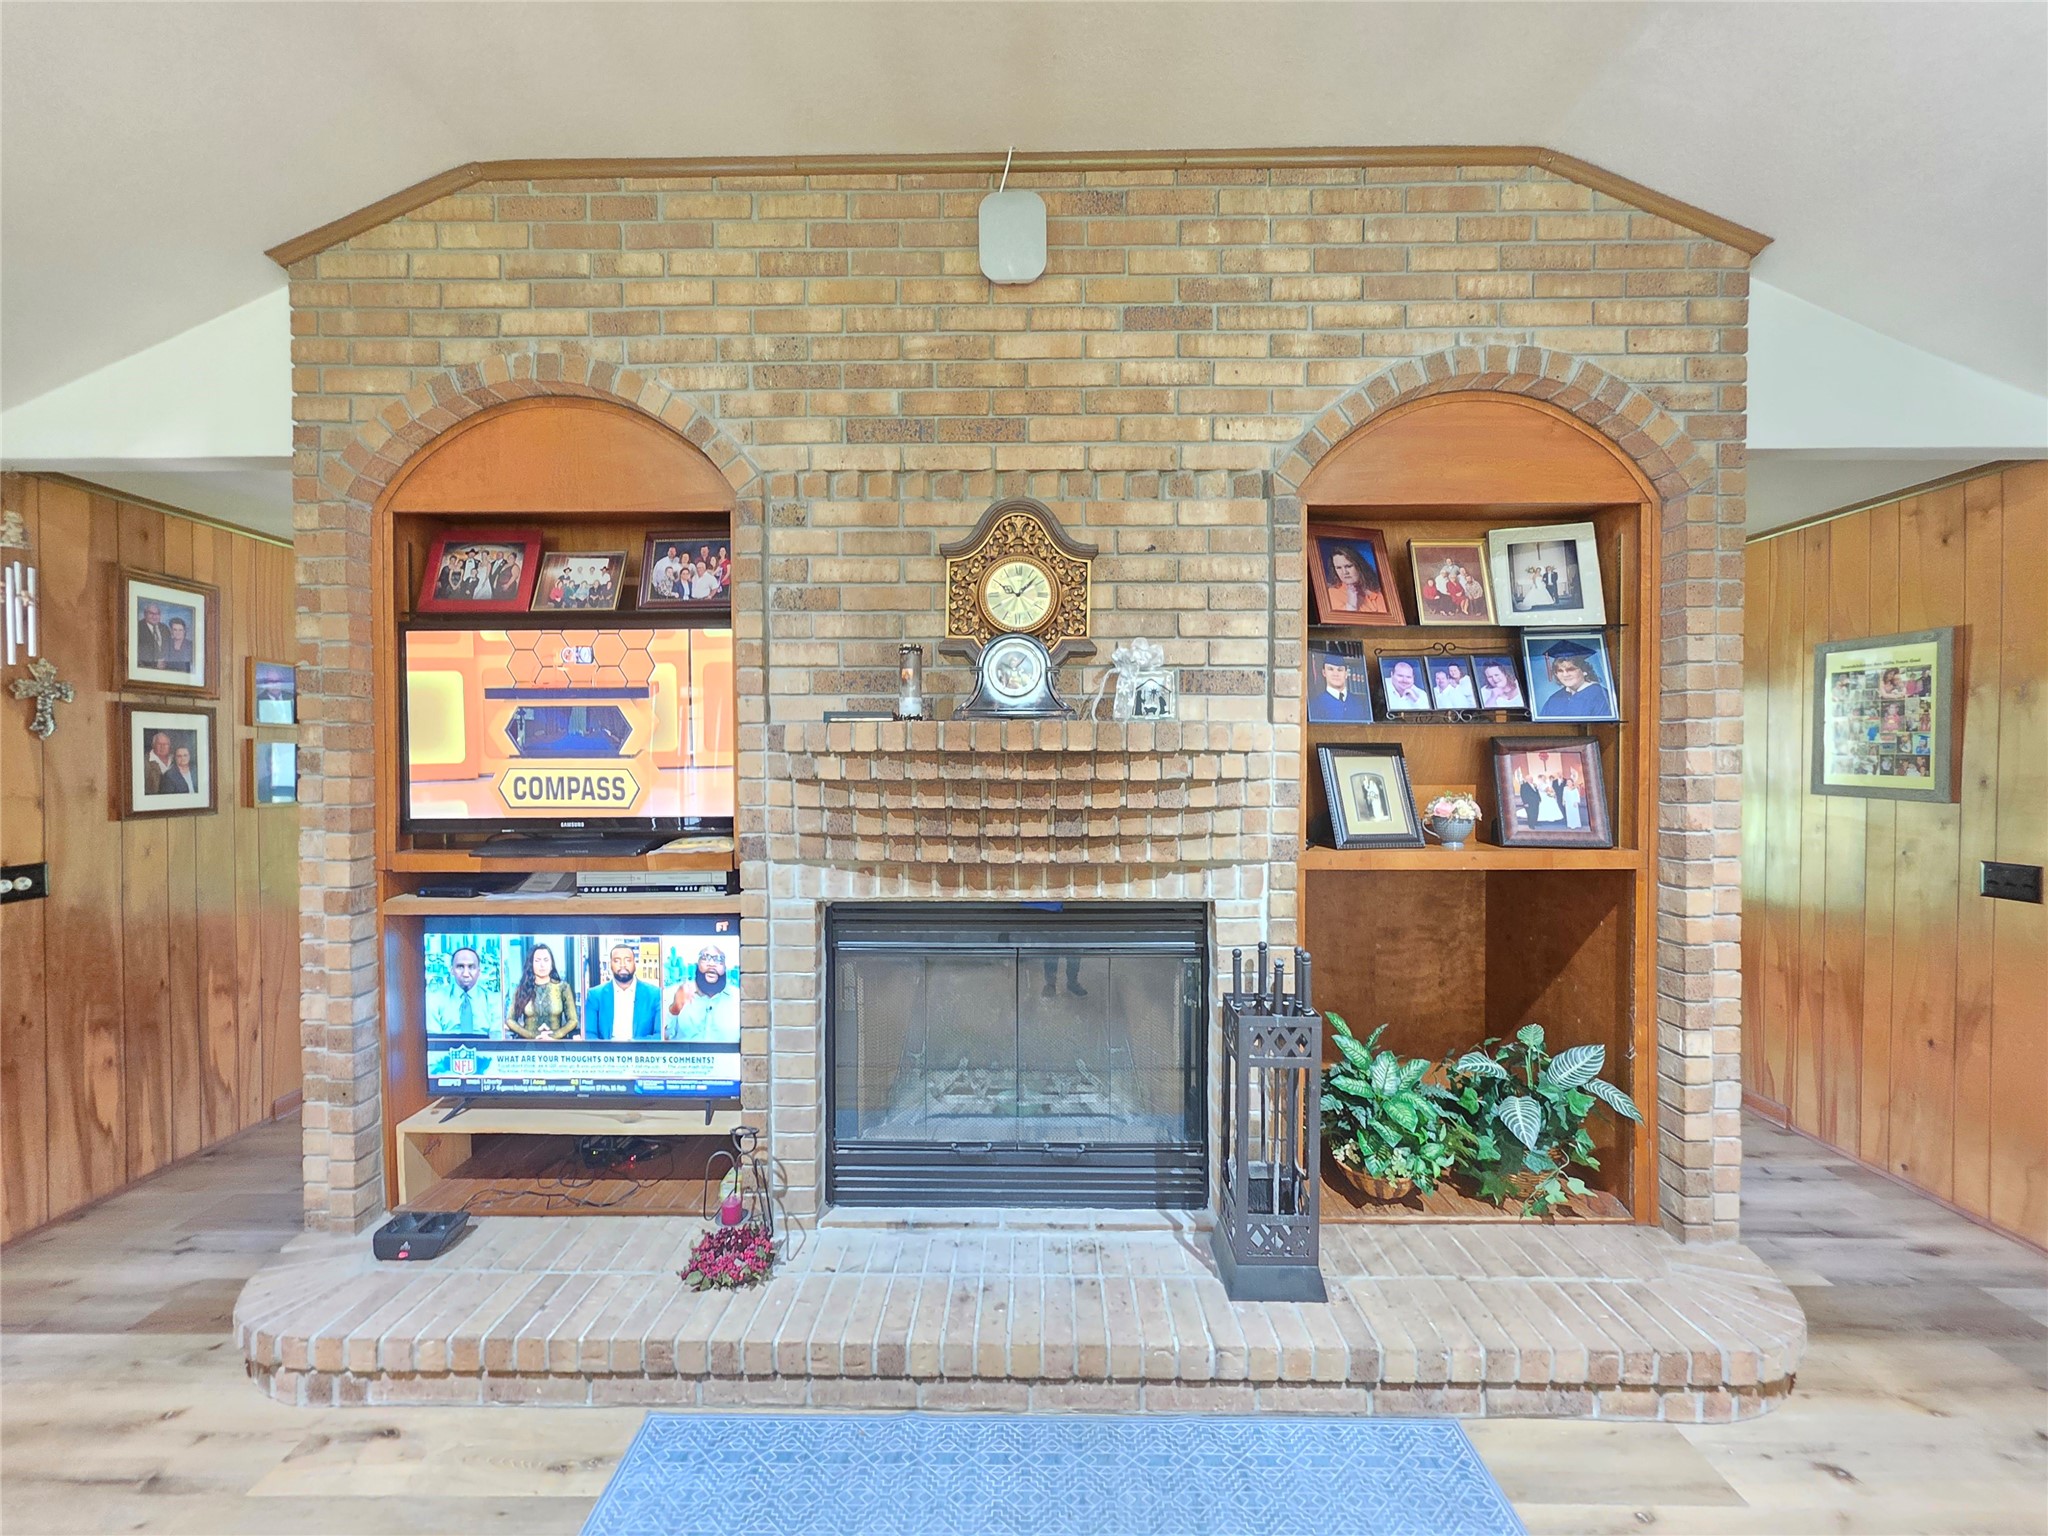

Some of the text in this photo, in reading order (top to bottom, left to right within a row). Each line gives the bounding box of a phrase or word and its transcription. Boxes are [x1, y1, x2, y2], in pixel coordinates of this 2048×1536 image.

[513, 776, 626, 801] COMPASS
[497, 1055, 519, 1063] WHAT
[521, 1055, 536, 1063] ARE
[538, 1055, 559, 1063] YOUR
[561, 1055, 602, 1064] THOUGHTS
[635, 1056, 667, 1064] BRADY'S
[669, 1056, 715, 1064] COMMENTS?
[454, 1061, 473, 1073] NFL
